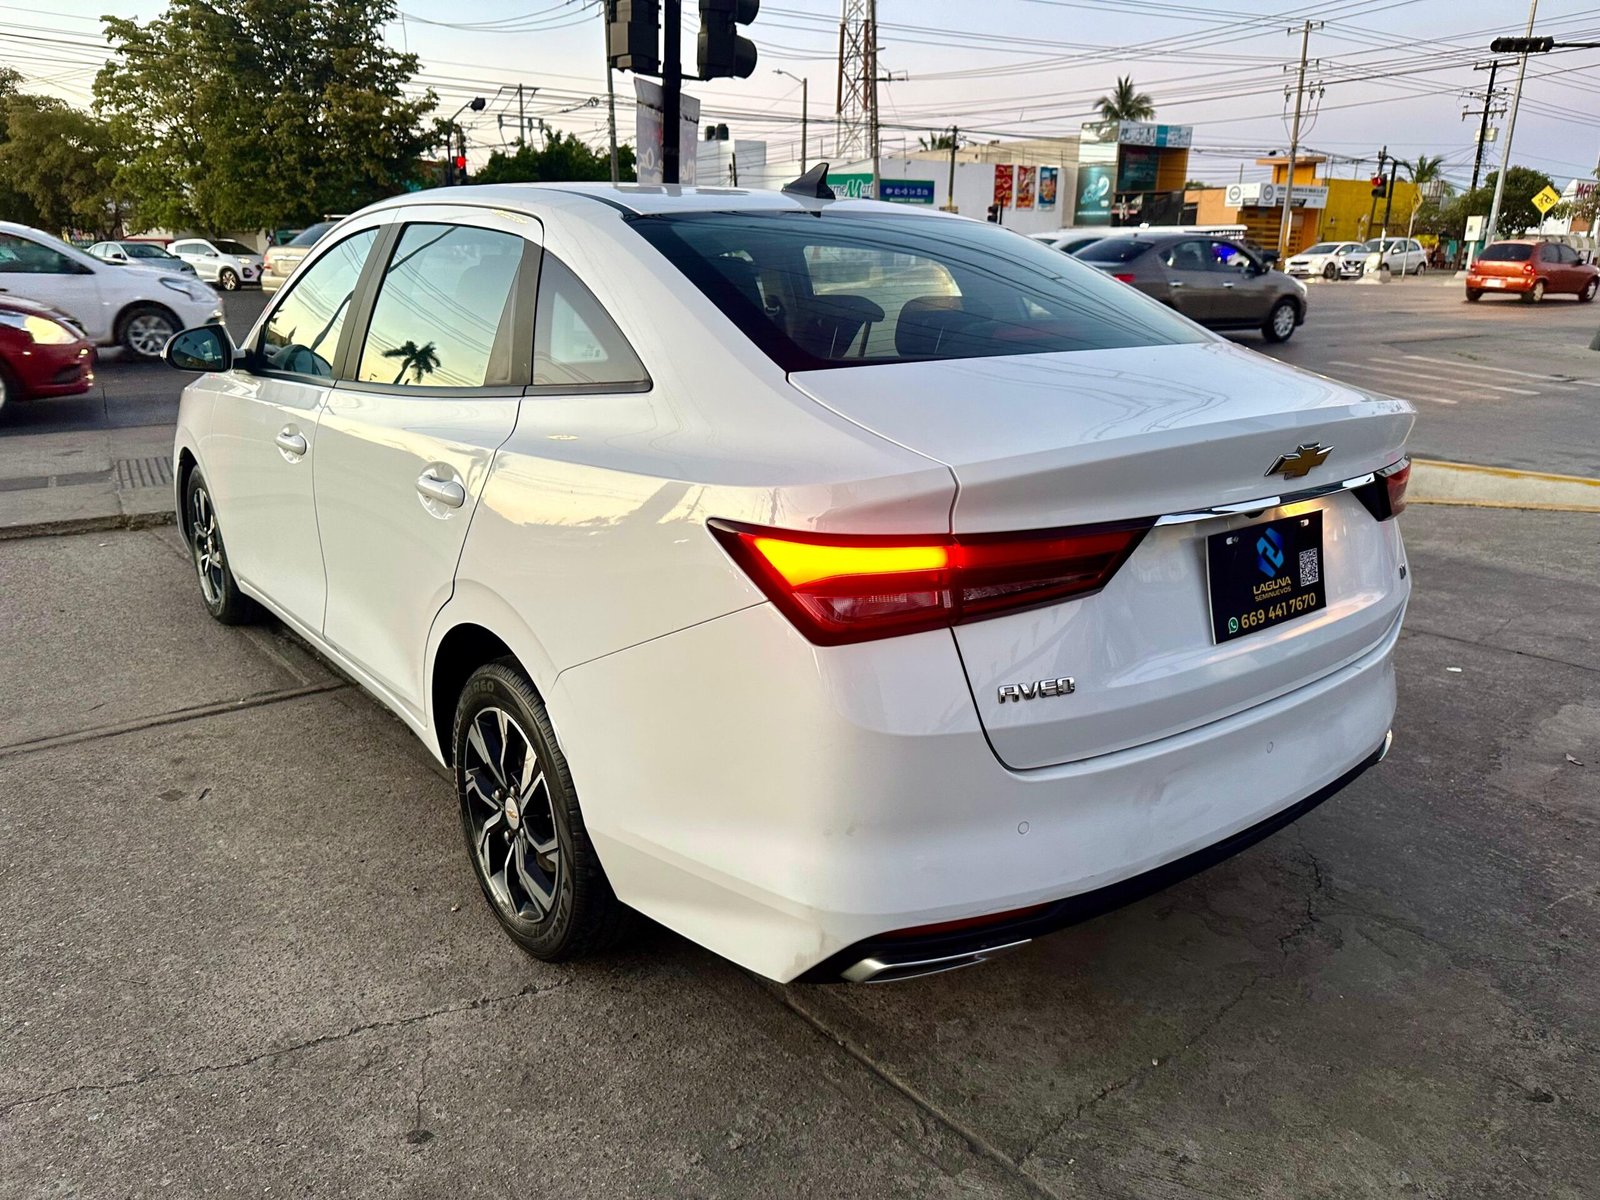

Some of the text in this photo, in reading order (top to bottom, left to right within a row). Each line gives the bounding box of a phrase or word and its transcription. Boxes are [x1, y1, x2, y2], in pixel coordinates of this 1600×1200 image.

[1253, 576, 1292, 595] LAGUNA
[1255, 587, 1292, 602] SEMINUEVOS
[1241, 592, 1316, 629] 669 441 7670
[998, 676, 1075, 704] AVEO
